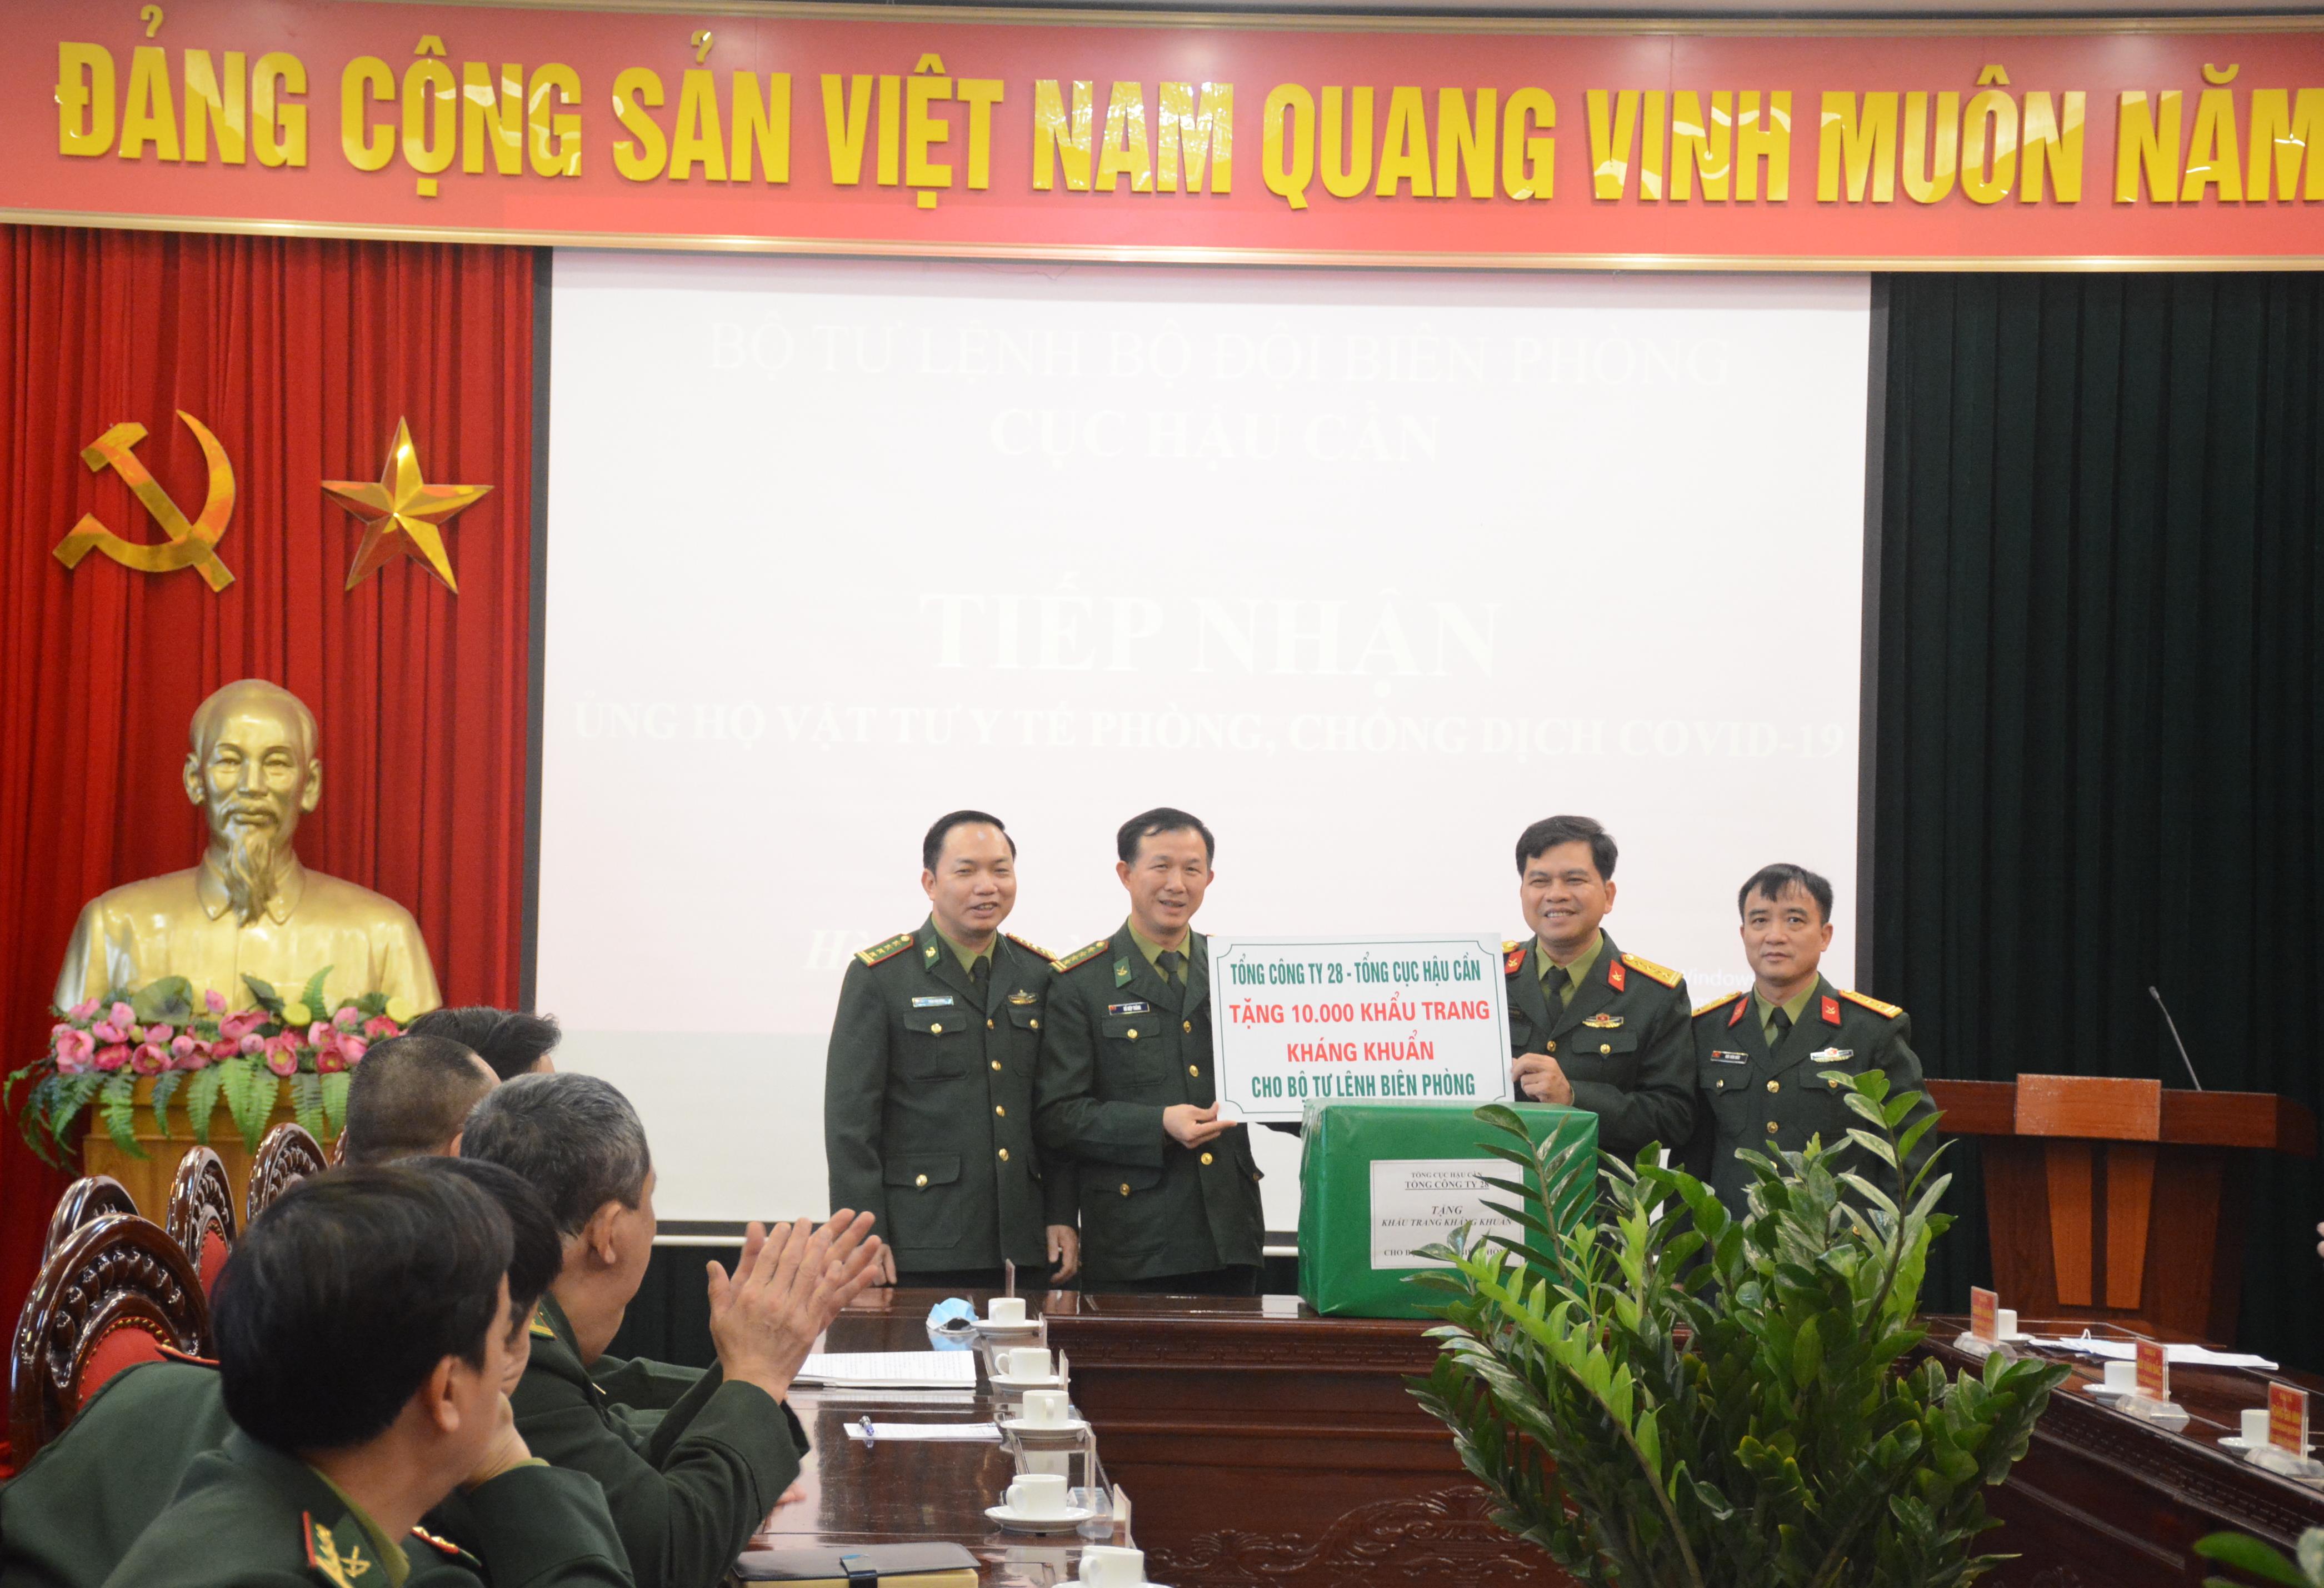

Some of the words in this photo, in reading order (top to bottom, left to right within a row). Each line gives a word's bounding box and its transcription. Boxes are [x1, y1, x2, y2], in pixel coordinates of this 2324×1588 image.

[54, 5, 307, 167] ĐẢNG
[340, 34, 582, 197] CỘNG
[612, 29, 791, 183] SẢN
[821, 53, 1003, 208] VIỆT
[1033, 79, 1233, 193] NAM
[1262, 83, 1556, 208] QUANG
[1586, 89, 1792, 202] VINH
[1817, 64, 2086, 204] MUÔN
[2115, 63, 2324, 203] NĂM
[708, 309, 794, 382] BỘ
[812, 319, 906, 374] TƯ
[918, 319, 1085, 385] LỆNH
[1107, 317, 1192, 388] BỘ
[1209, 319, 1322, 391] ĐỘI
[1341, 321, 1491, 383] BIÊN
[1511, 323, 1729, 387] PHÒNG
[990, 407, 1127, 470] CỤC
[1144, 403, 1283, 472] HẬU
[918, 570, 1164, 671] TIẾP
[1190, 586, 1503, 698] NHẬN
[689, 698, 766, 750] HỘ
[778, 701, 878, 751] VẬT
[891, 702, 962, 746] TƯ
[968, 708, 1003, 746] Y
[1013, 696, 1076, 746] TẾ
[1089, 701, 1276, 757] PHÒNG,
[1288, 706, 1470, 753] CHỐNG
[1481, 717, 1607, 763] DỊCH
[1619, 719, 1845, 758] COVID-19
[1230, 953, 1265, 985] TỔNG
[1269, 958, 1305, 984] CÔNG
[1309, 963, 1323, 984] TY
[1327, 962, 1343, 983] 28
[1354, 951, 1389, 983] TỔNG
[1393, 960, 1419, 987] CỤC
[1423, 955, 1449, 986] HẬU
[1453, 952, 1481, 981] CẦN
[1230, 998, 1284, 1029] TẶNG
[1292, 1003, 1354, 1023] 10.000
[1361, 991, 1416, 1021] KHẨU
[1422, 1000, 1490, 1020] TRANG
[1287, 1037, 1357, 1062] KHÁNG
[1364, 1029, 1433, 1061] KHUẨN
[1251, 1075, 1282, 1098] CHO
[1288, 1070, 1307, 1103] BỘ
[1313, 1073, 1332, 1097] TƯ
[1381, 1069, 1417, 1096] BIÊN
[1422, 1068, 1476, 1096] PHÒNG
[1435, 1178, 1462, 1188] CÔNG
